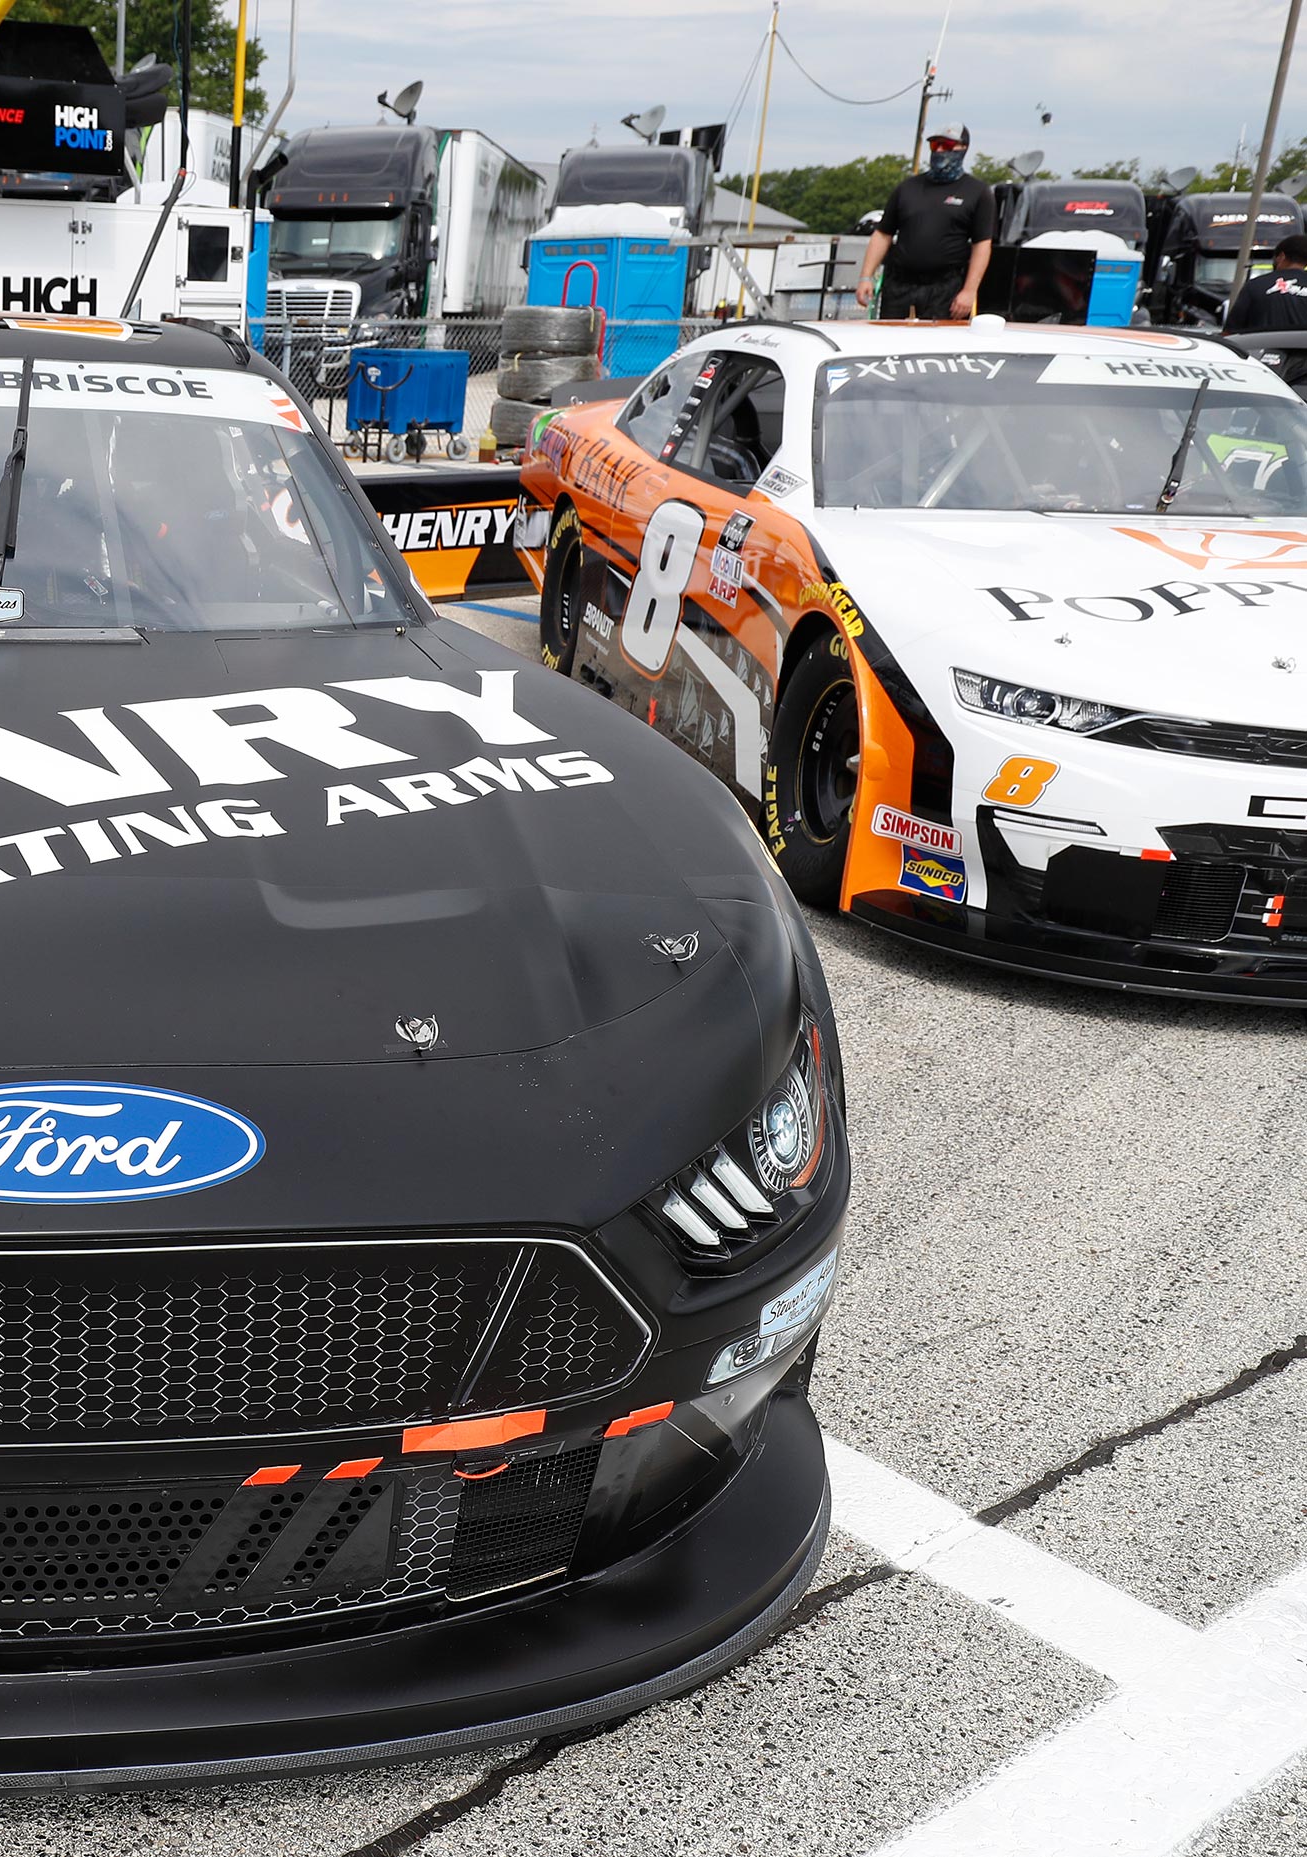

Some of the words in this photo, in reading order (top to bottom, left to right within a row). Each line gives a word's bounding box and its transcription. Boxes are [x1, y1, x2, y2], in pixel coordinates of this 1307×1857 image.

[55, 104, 98, 130] HIGH
[55, 127, 107, 150] POINT
[1213, 214, 1292, 224] MENRDS
[2, 276, 97, 316] HIGH
[854, 354, 1006, 381] xfinity
[1104, 362, 1247, 383] HEMRIC
[383, 508, 517, 550] HENRY
[621, 500, 706, 672] 8
[710, 575, 737, 602] ARP
[974, 581, 1307, 622] POPP
[583, 602, 615, 640] BRANDT
[324, 750, 615, 826] ARMS
[983, 755, 1059, 807] 8
[880, 811, 955, 850] SIMPSON
[906, 860, 962, 886] SUNOCO
